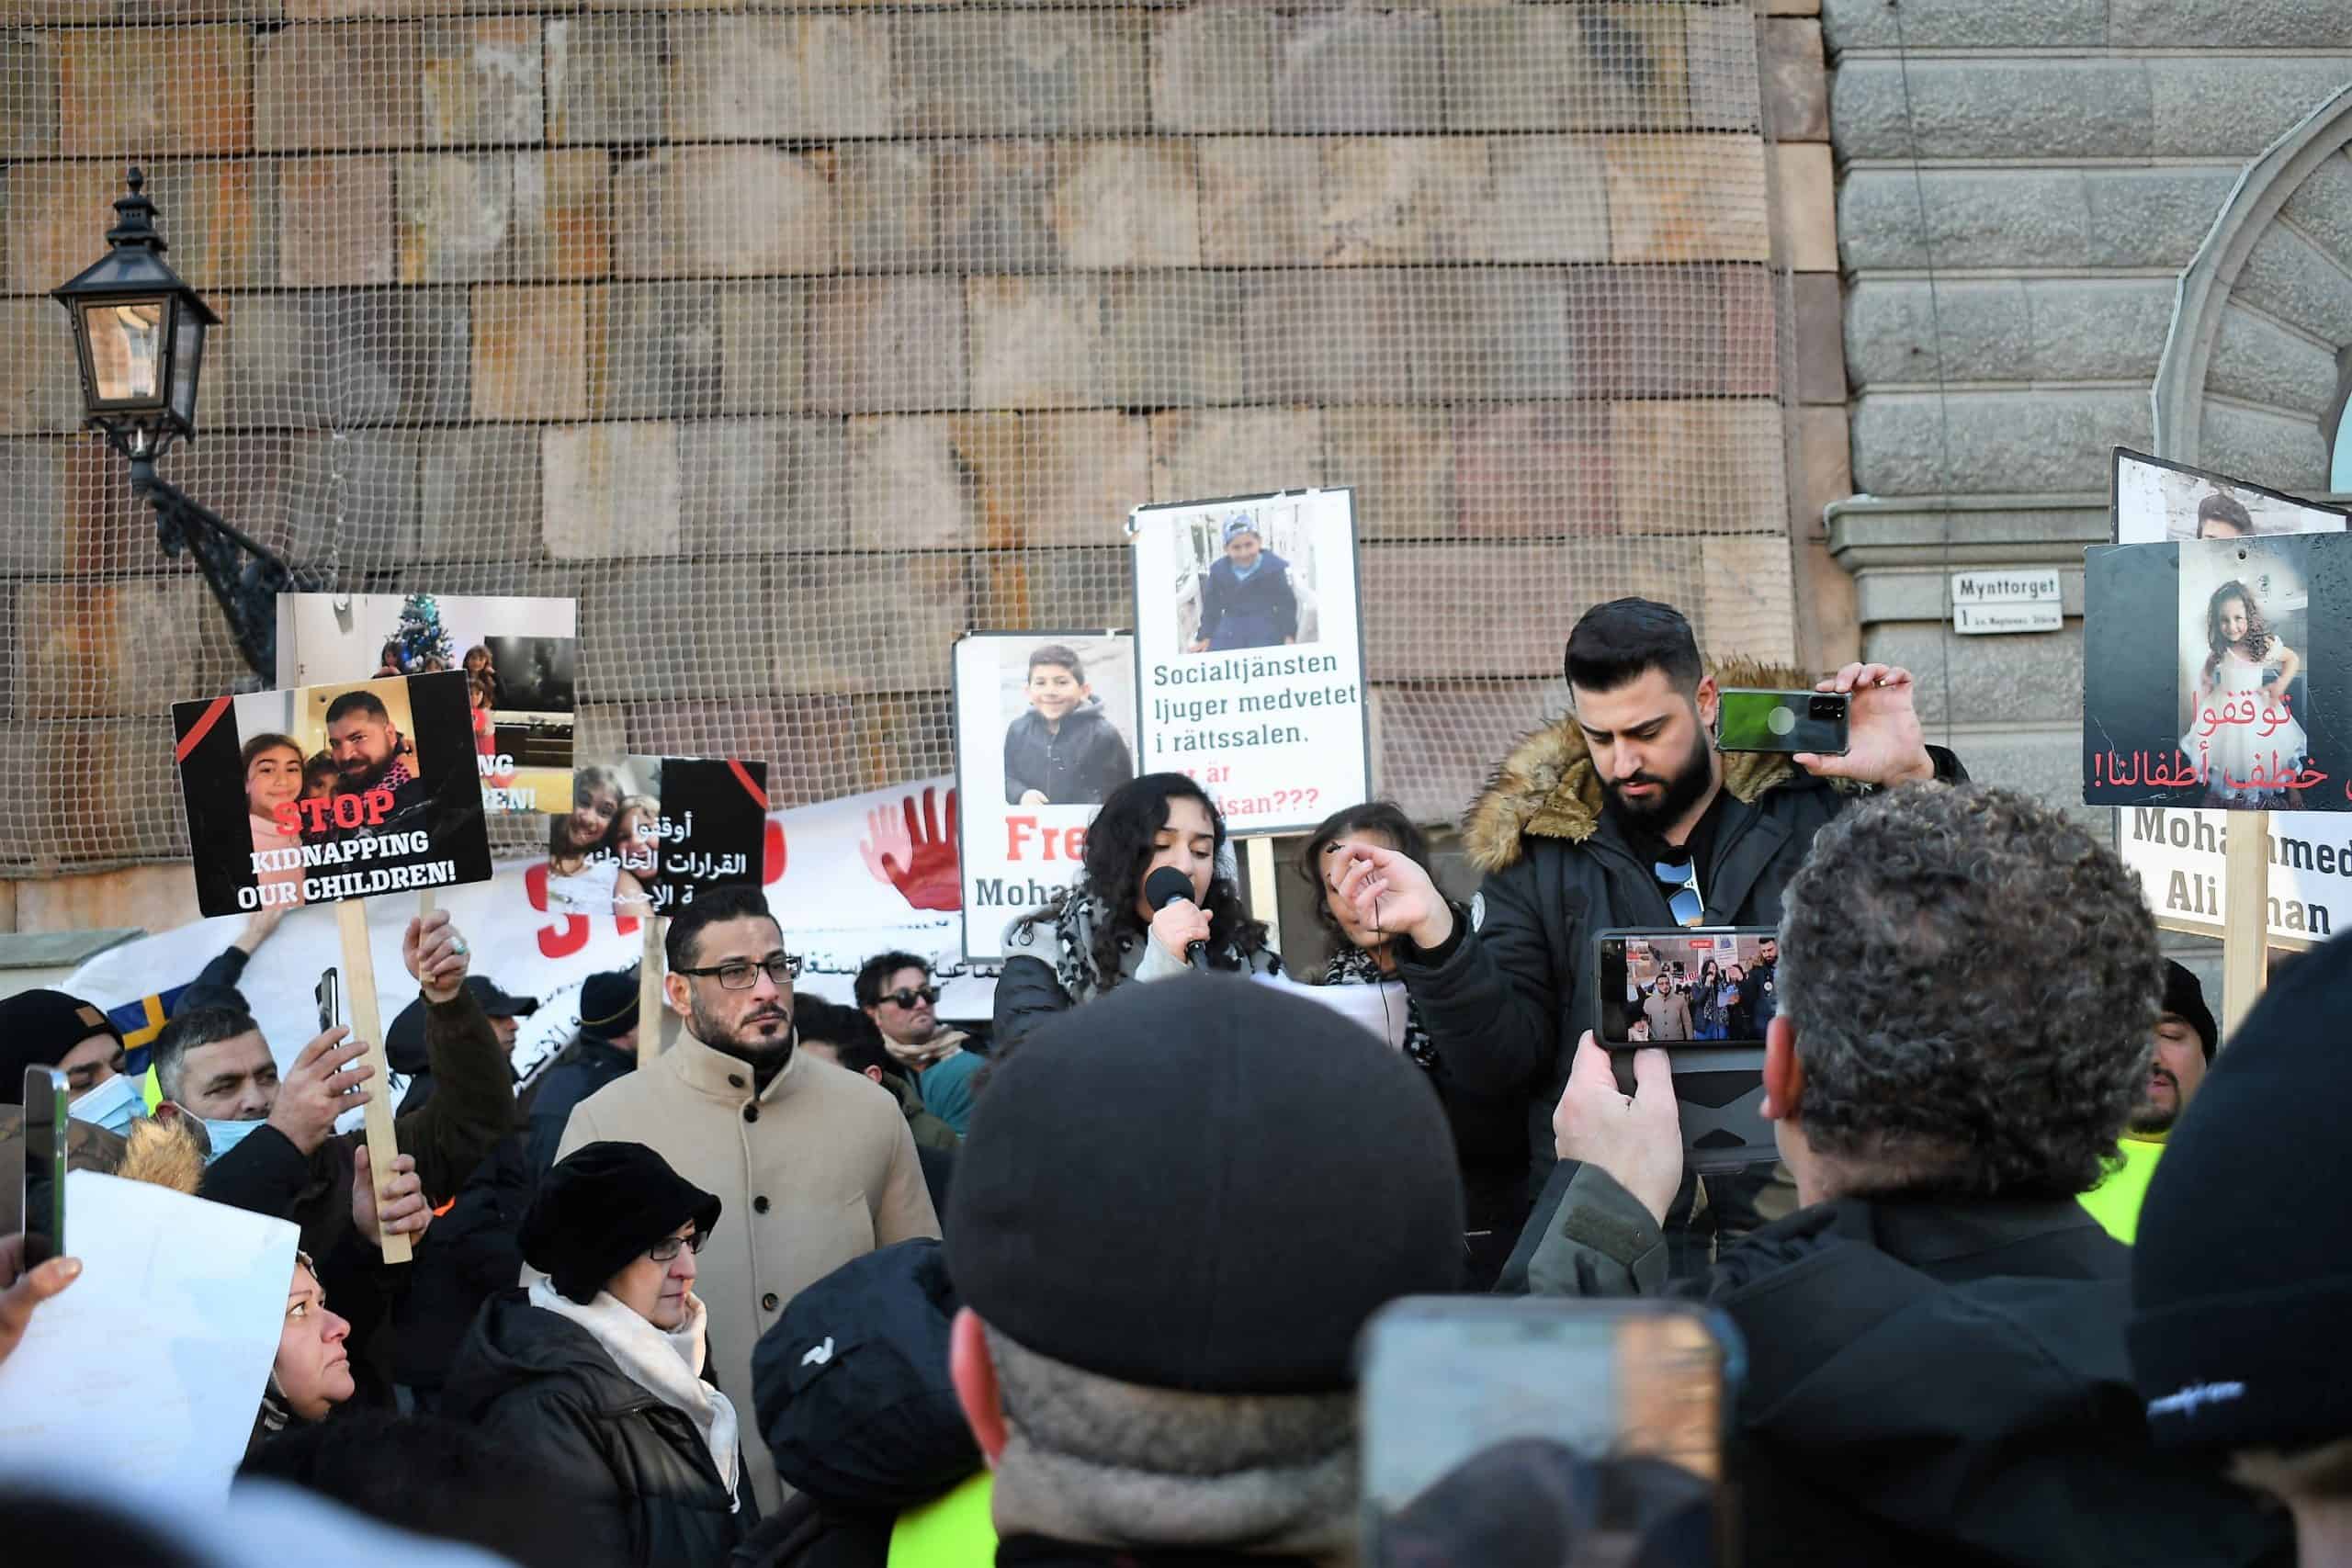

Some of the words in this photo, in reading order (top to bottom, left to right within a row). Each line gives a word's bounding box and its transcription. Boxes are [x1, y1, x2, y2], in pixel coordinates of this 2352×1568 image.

[1960, 579, 2054, 600] Mynttorget
[1153, 654, 1338, 686] Socialtjänsten
[1155, 698, 1228, 724] ljuger
[1238, 684, 1357, 713] medvetet
[2190, 689, 2293, 736] توقفوا
[1156, 732, 1162, 753] i
[1173, 724, 1309, 752] rättssalen.
[1206, 760, 1231, 783] är
[2223, 749, 2329, 789] خطف
[272, 788, 395, 836] STOP
[632, 811, 693, 843] أوقفوا
[250, 830, 429, 874] KIDNAPPING
[1005, 815, 1088, 861] Fre
[2133, 808, 2352, 877] Mohmed
[237, 880, 299, 909] OUR
[302, 860, 457, 901] CHILDREN!
[666, 852, 747, 879] القرارات
[2165, 869, 2218, 917] Ali
